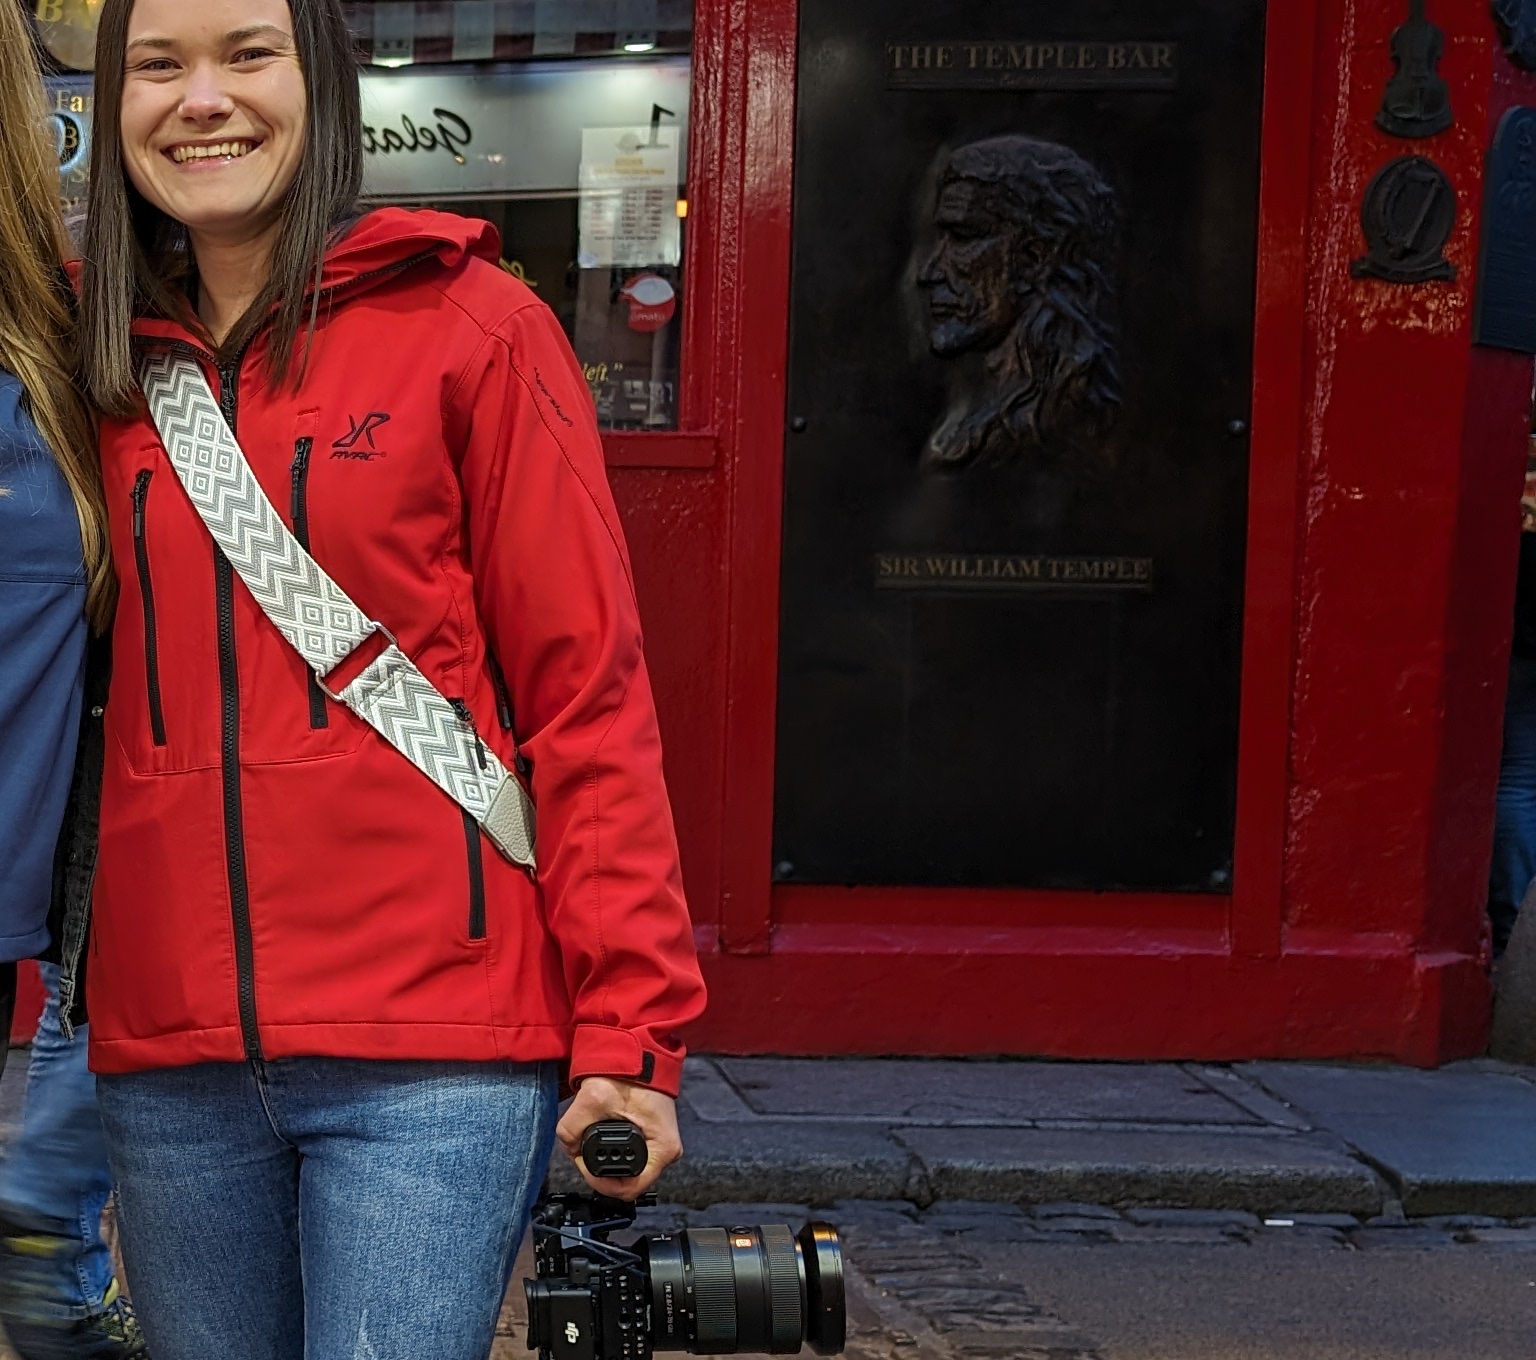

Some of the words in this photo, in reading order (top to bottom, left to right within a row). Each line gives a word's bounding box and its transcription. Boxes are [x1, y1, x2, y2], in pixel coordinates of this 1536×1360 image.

[887, 44, 954, 69] THE
[963, 44, 1097, 70] TEMPLE
[1106, 44, 1175, 69] BAR
[878, 556, 919, 577] SIR
[925, 557, 1041, 579] WILLIAM
[1045, 557, 1149, 580] TEMPLE
